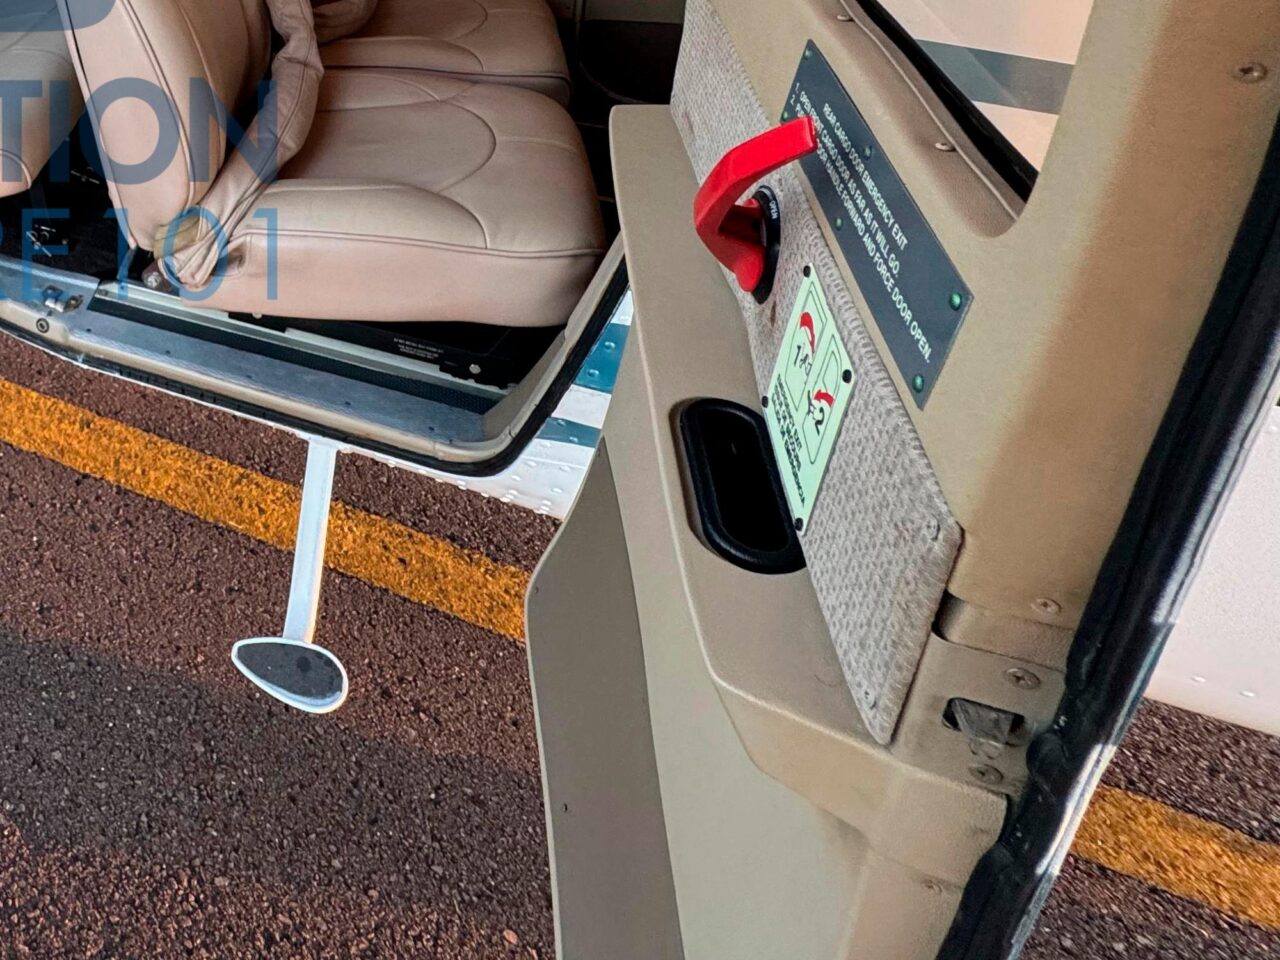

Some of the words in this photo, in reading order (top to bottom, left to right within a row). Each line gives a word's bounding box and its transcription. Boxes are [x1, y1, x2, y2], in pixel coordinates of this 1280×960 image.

[769, 200, 778, 220] OPEN
[800, 91, 811, 113] OPEN
[821, 130, 838, 160] CARGO
[835, 157, 850, 181] DOOR
[847, 178, 856, 194] AS
[853, 191, 865, 211] FAR
[864, 208, 872, 225] AS
[871, 219, 878, 234] IT
[876, 231, 890, 257] WILL
[888, 253, 899, 277] GO.
[824, 103, 836, 128] REAR
[834, 122, 852, 154] CARGO
[850, 148, 865, 175] DOOR
[862, 170, 894, 228] EMERGENCY
[892, 224, 908, 250] EXIT
[825, 161, 844, 195] HANDLE
[842, 191, 864, 235] FORWARD
[863, 234, 875, 256] AND
[874, 255, 894, 290] FORCE
[892, 287, 912, 325] DOOR
[910, 321, 932, 363] OPEN.
